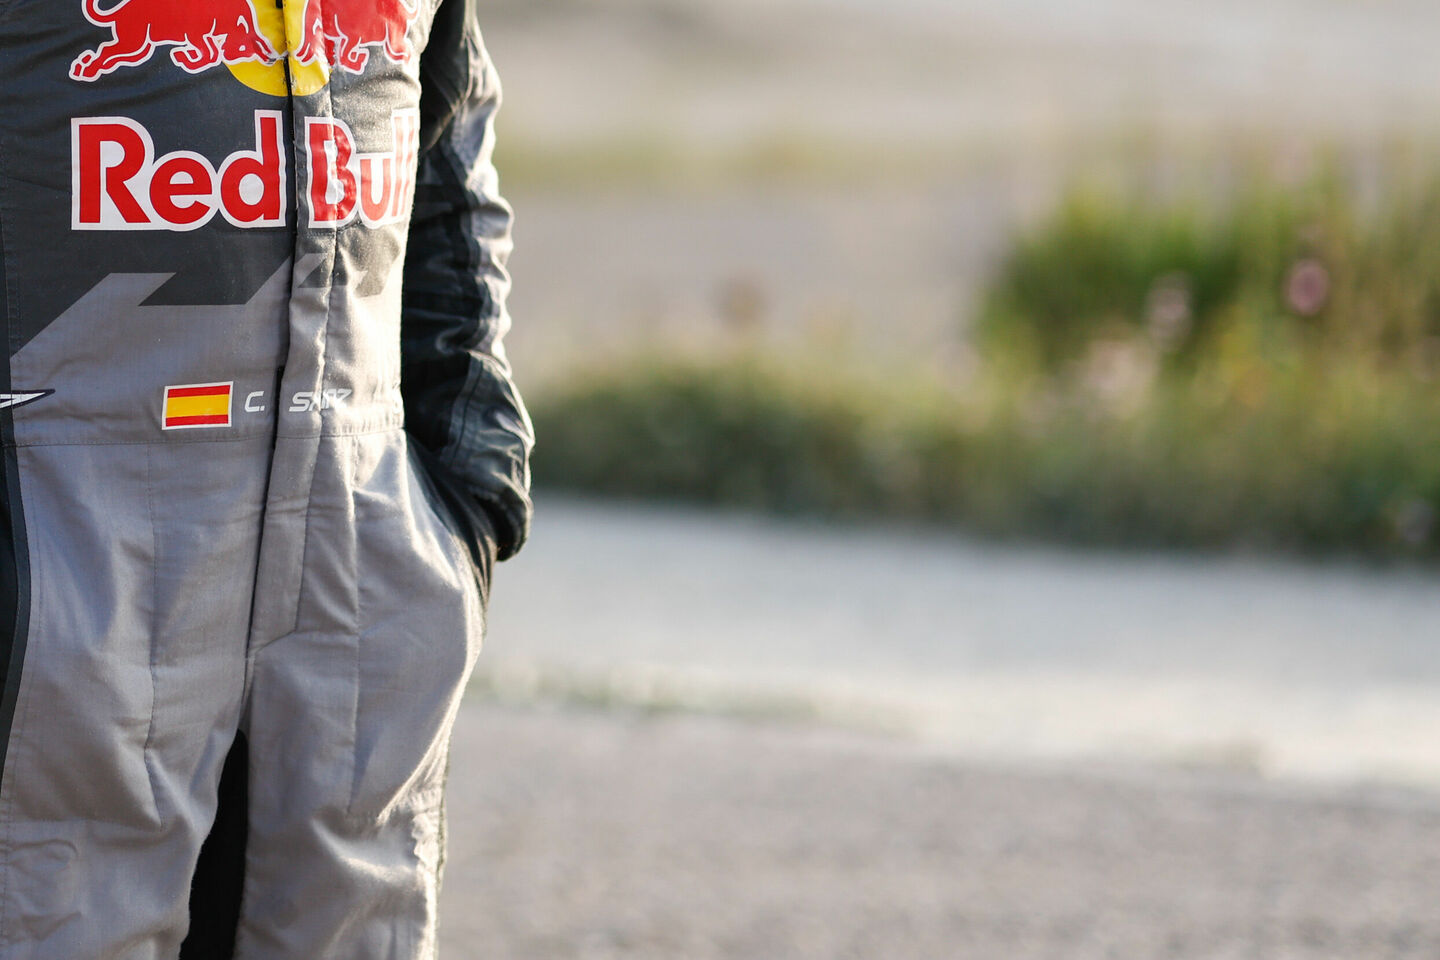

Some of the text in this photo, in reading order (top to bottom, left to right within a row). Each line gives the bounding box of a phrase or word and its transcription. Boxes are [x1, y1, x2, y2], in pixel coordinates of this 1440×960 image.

[71, 108, 419, 231] Red Bull
[244, 390, 265, 413] C.
